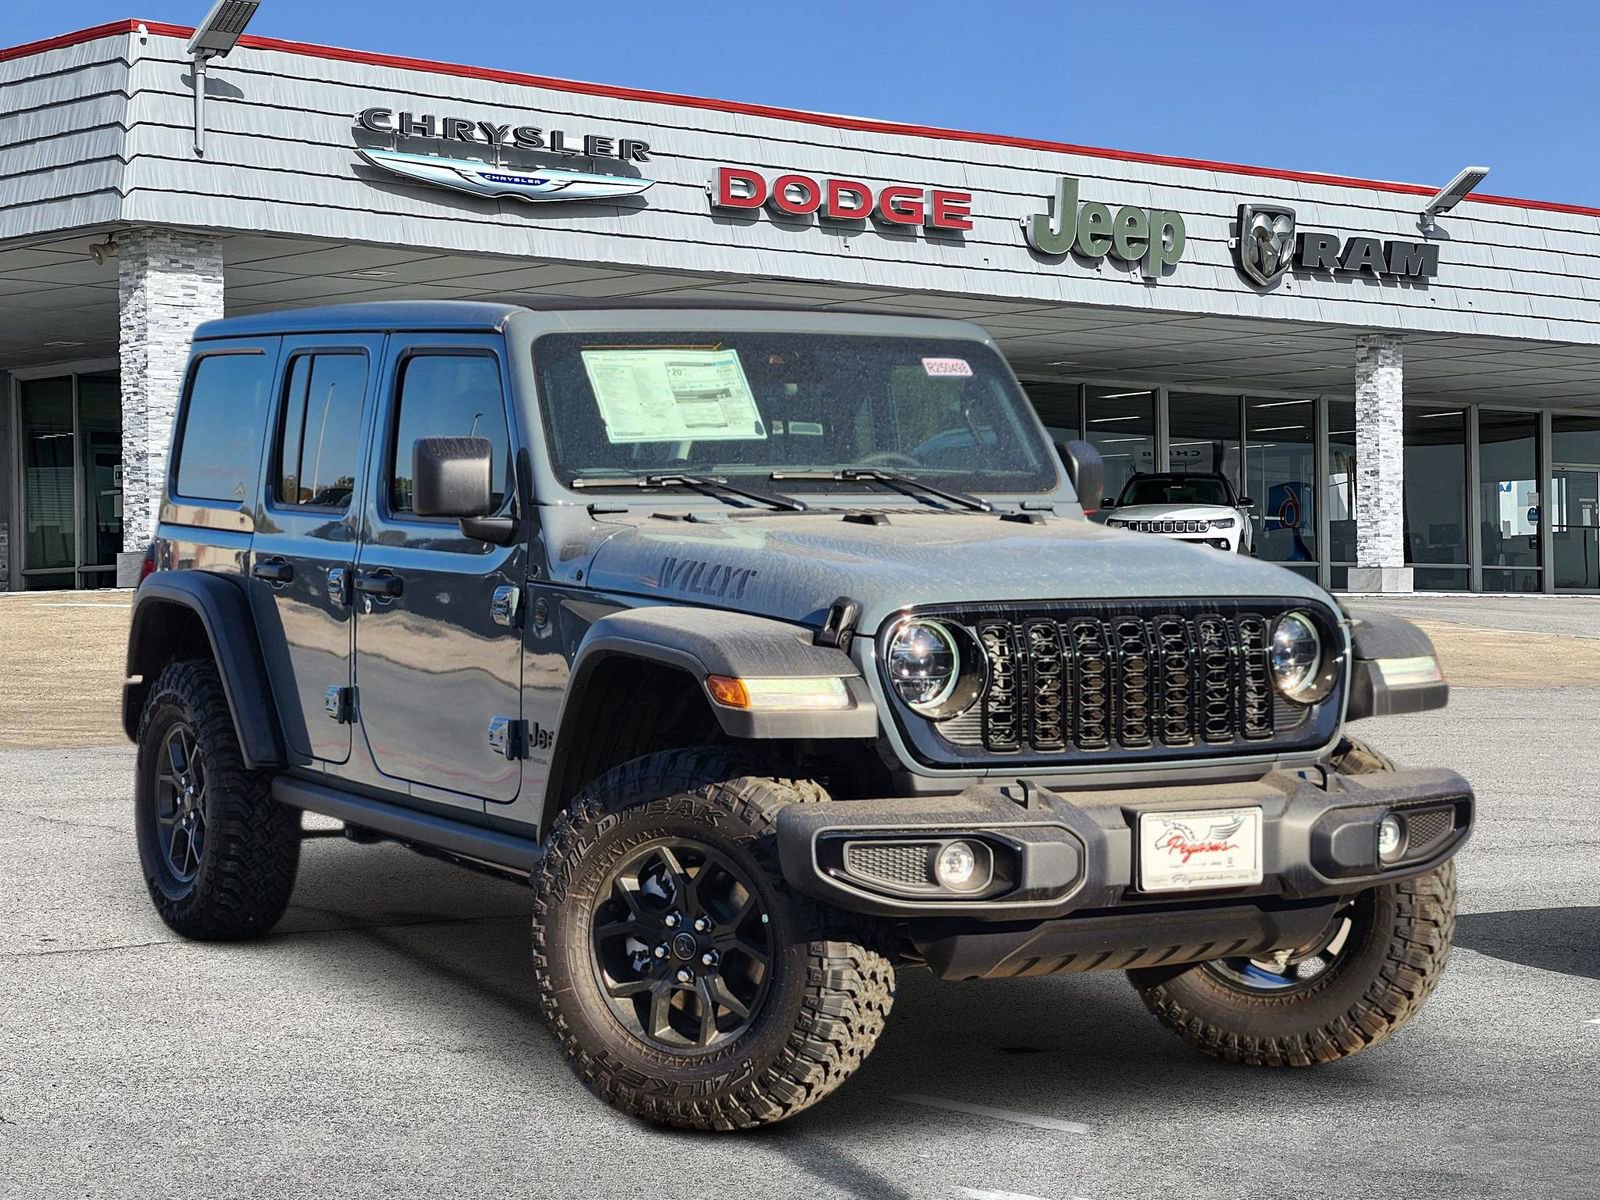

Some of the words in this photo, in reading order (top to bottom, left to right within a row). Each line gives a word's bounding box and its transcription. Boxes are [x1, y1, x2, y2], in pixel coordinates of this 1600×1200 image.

[359, 107, 650, 161] CHRYSLER
[484, 174, 541, 185] CHRYSLER
[711, 166, 974, 231] DODGE
[1027, 176, 1186, 279] Jeep
[1297, 231, 1440, 279] RAM
[1167, 834, 1240, 864] Pegasus
